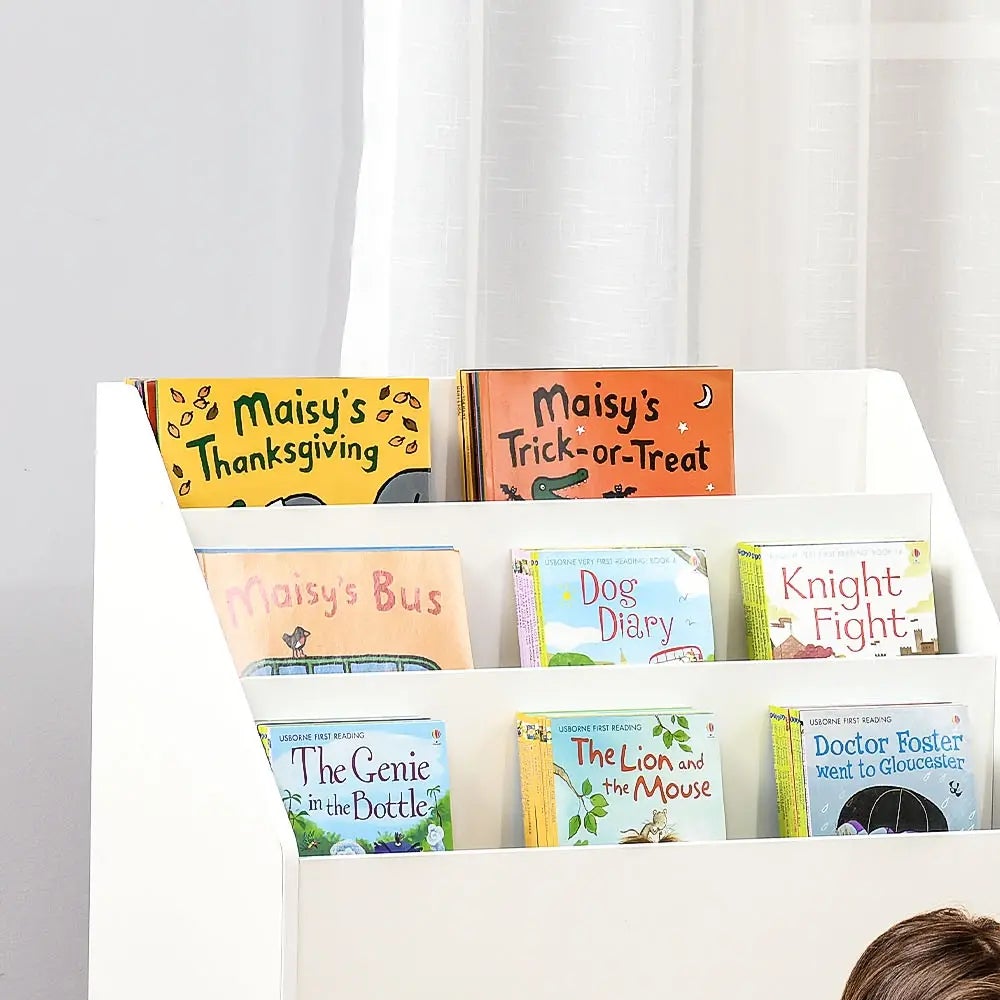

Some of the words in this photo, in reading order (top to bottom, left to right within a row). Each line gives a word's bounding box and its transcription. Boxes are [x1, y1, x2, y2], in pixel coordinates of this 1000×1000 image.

[233, 388, 367, 436] Maisy's
[533, 381, 660, 434] Maisy's
[186, 433, 379, 481] Thanksgiving
[498, 426, 710, 472] Trick-or-Treat
[544, 558, 577, 567] USBORNE
[225, 571, 358, 628] Maisy's
[372, 570, 442, 616] Bus
[580, 569, 638, 609] Dog
[781, 561, 903, 611] Knight
[598, 606, 674, 646] Diary
[814, 602, 908, 653] Fight
[279, 733, 312, 742] USBORNE
[314, 732, 331, 741] FIRST
[333, 731, 365, 740] READING
[558, 724, 591, 733] USBORNE
[592, 724, 610, 732] FIRST
[611, 723, 642, 732] READING
[809, 717, 841, 726] USBORNE
[843, 717, 860, 725] FIRST
[862, 715, 893, 724] READING
[570, 737, 616, 768] The
[620, 744, 674, 772] Lion
[678, 752, 705, 770] and
[814, 732, 889, 756] Doctor
[896, 729, 964, 754] Foster
[291, 746, 347, 786] The
[351, 746, 431, 784] Genie
[815, 759, 854, 780] went
[858, 758, 876, 778] to
[879, 754, 966, 775] Gloucester
[308, 793, 322, 811] in
[326, 793, 351, 816] the
[352, 788, 428, 820] Bottle
[602, 777, 630, 796] the
[634, 774, 712, 804] Mouse
